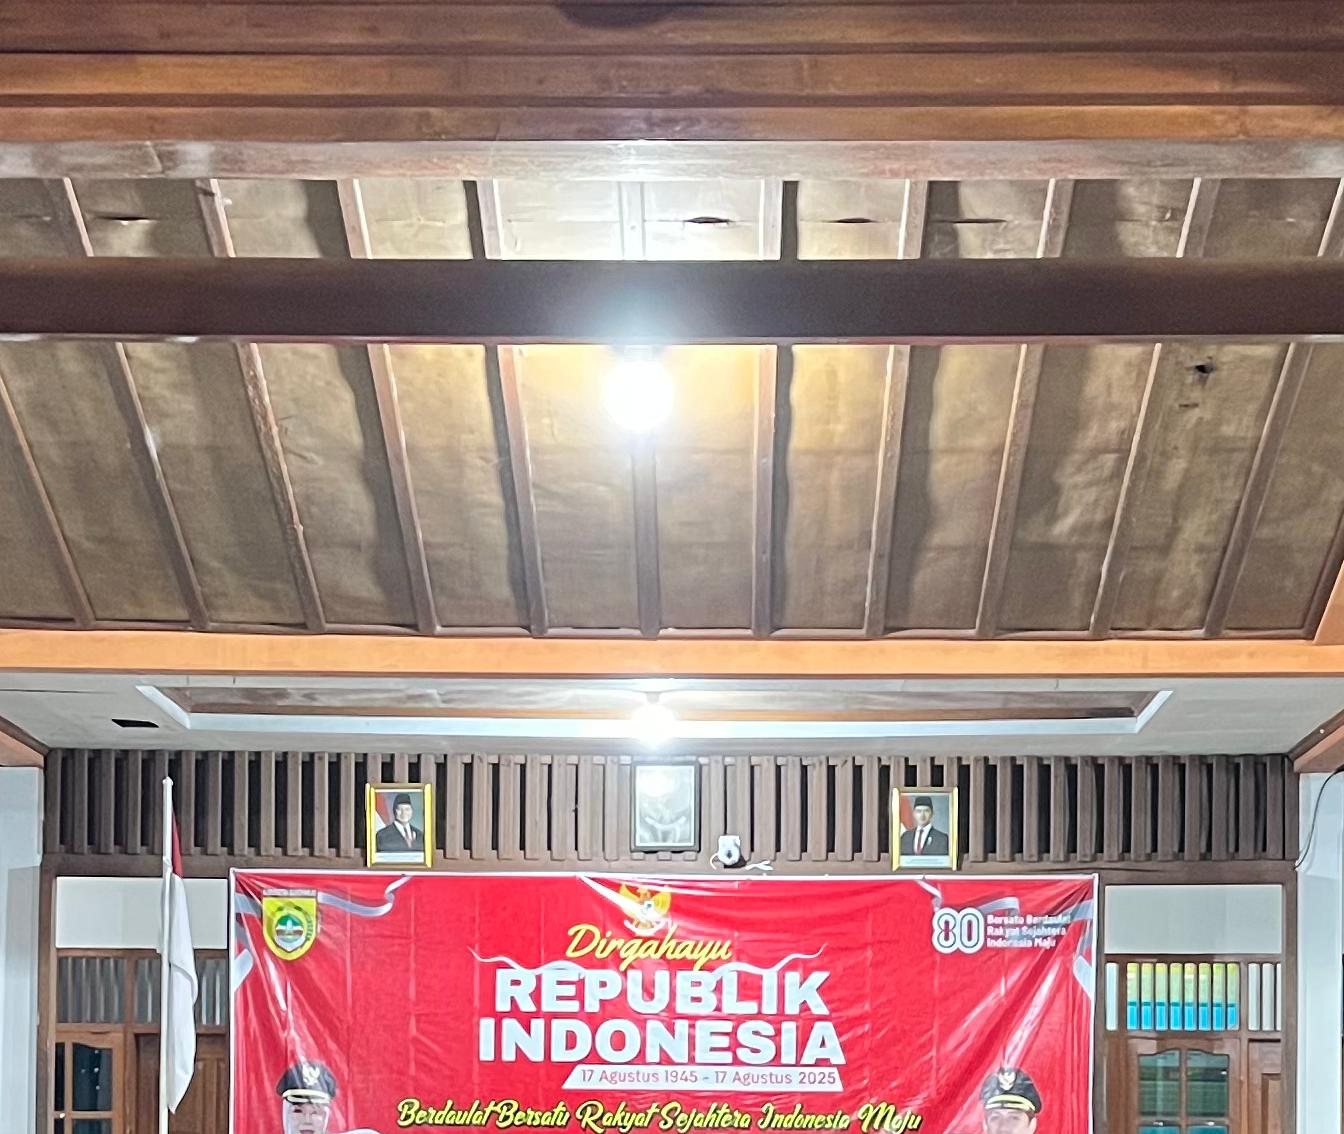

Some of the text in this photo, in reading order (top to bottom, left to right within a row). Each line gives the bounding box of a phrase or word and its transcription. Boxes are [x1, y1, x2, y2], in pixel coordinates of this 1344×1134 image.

[566, 922, 733, 971] Dirgahayu
[932, 907, 984, 954] 80
[494, 967, 830, 1016] REPUBLIK
[478, 1017, 846, 1065] INDONESIA
[581, 1069, 594, 1083] 17
[599, 1069, 659, 1086] Agustus
[664, 1069, 698, 1083] 1945
[715, 1070, 727, 1084] 17
[732, 1070, 792, 1087] Agustus
[798, 1071, 837, 1085] 2025
[397, 1098, 922, 1134] Berdaulat Bersatu Rakyat Sejahtera Indonesia Maju
